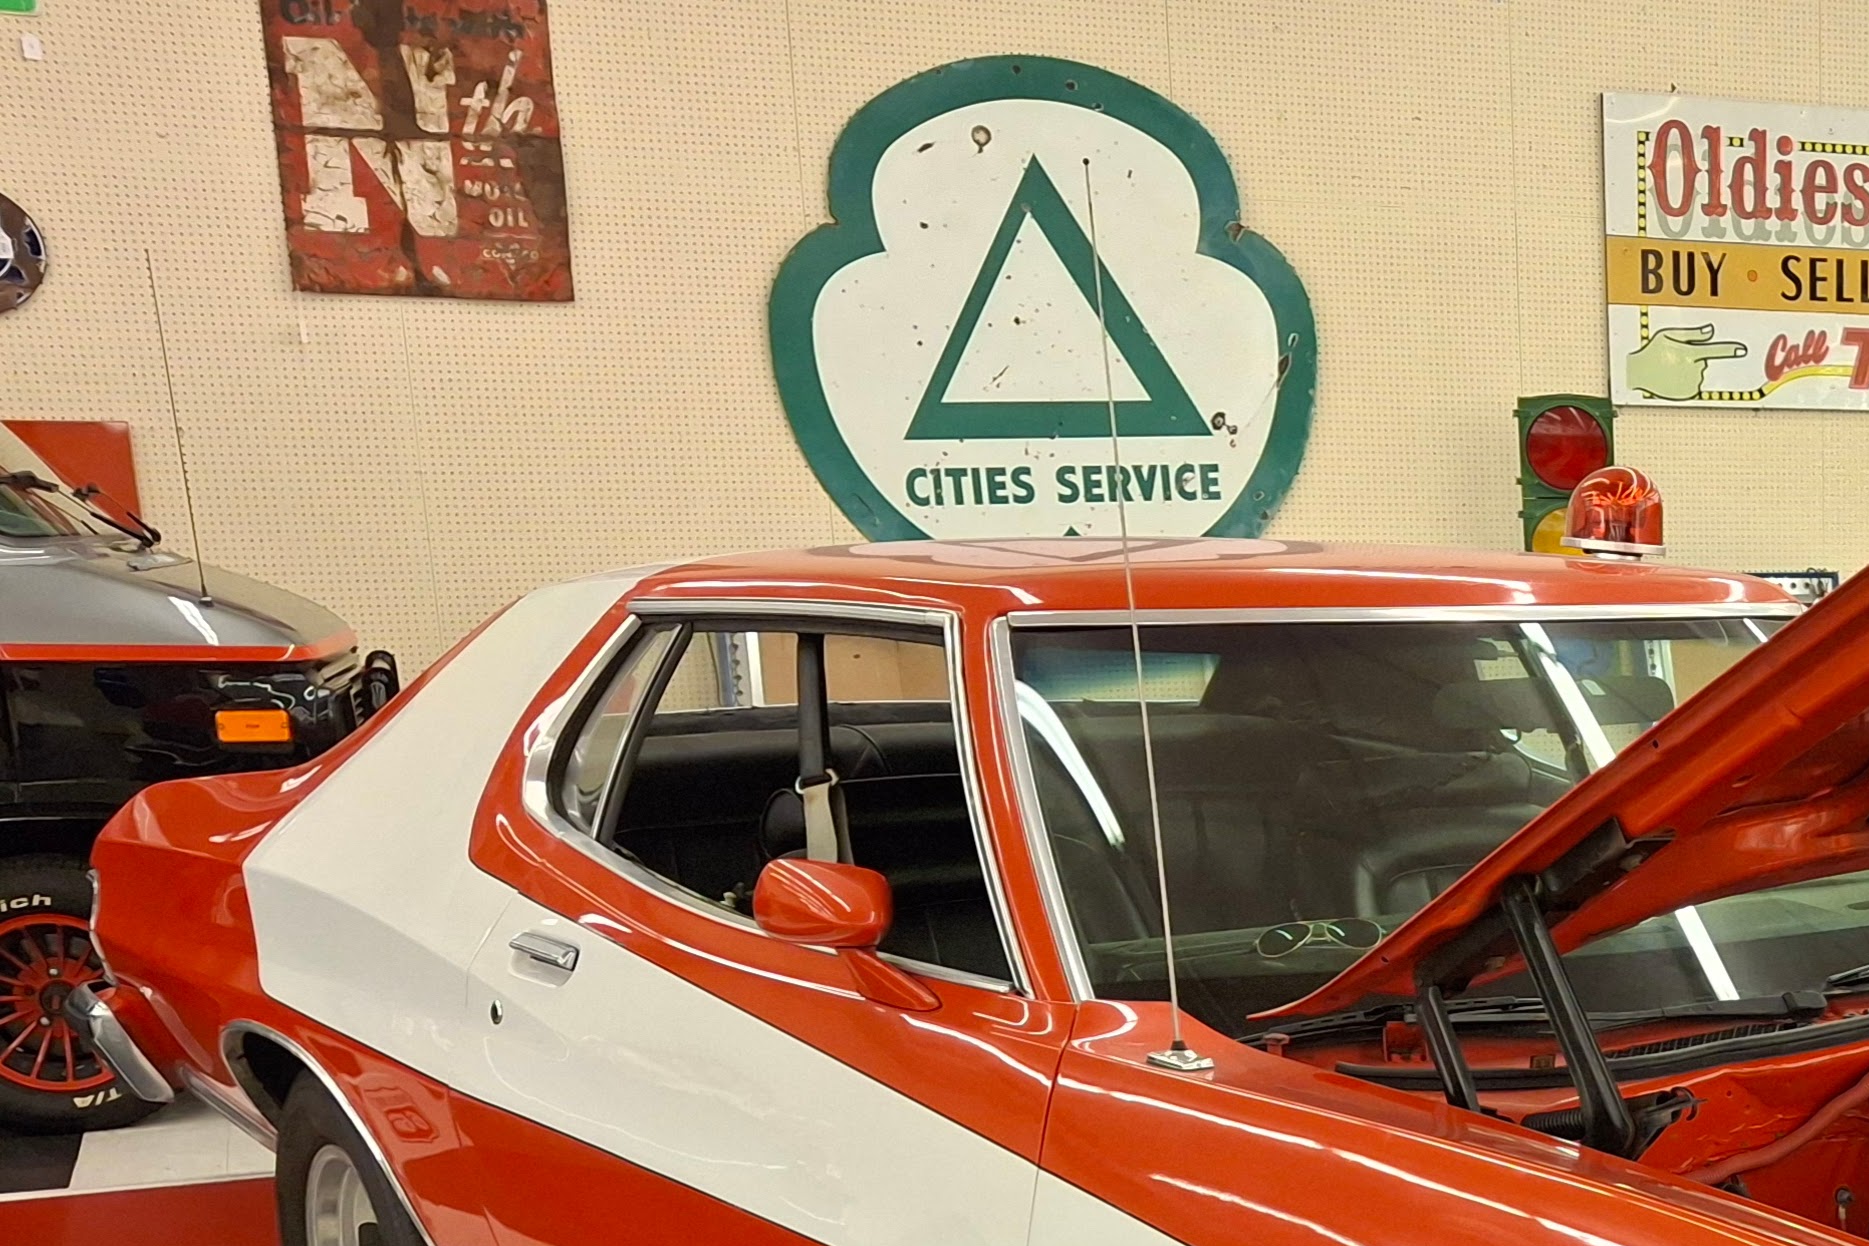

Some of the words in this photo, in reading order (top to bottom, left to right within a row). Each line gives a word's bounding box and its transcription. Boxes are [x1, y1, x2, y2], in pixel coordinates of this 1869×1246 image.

[488, 206, 529, 228] OIL
[1641, 249, 1728, 297] BUY
[1764, 329, 1830, 382] Call
[905, 466, 1036, 507] CITIES
[1054, 463, 1223, 504] SERVICE
[73, 1086, 122, 1109] T/A
